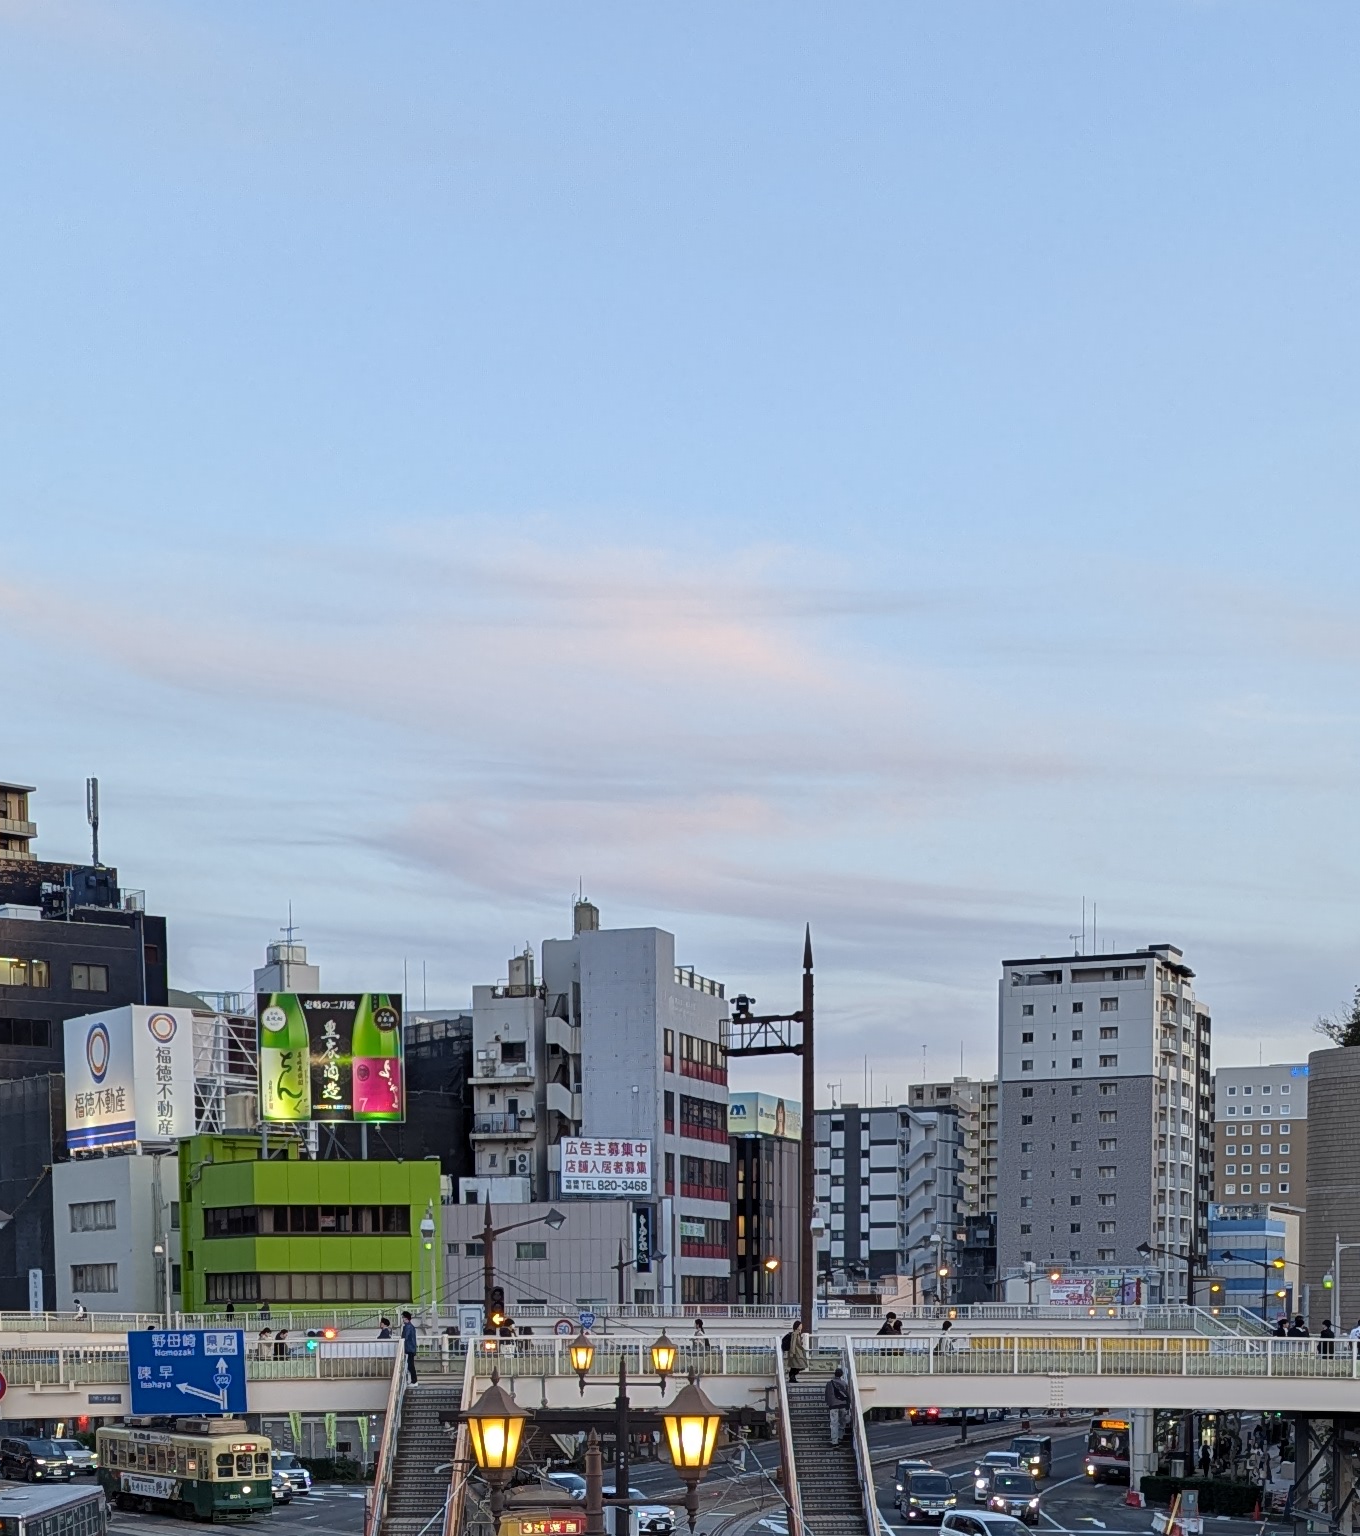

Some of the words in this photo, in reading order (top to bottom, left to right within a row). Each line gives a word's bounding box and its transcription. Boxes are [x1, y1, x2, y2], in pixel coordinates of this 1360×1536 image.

[155, 1046, 174, 1136] 福徳不動産
[74, 1086, 127, 1119] 福徳不動産
[565, 1141, 648, 1157] 広告主募集中
[565, 1161, 648, 1175] 店舗入居者募集
[581, 1181, 596, 1190] TEL
[597, 1180, 648, 1191] 820-3468
[152, 1334, 196, 1348] 野母崎
[206, 1335, 235, 1347] 県庁
[155, 1348, 195, 1356] Nomozaki
[141, 1381, 172, 1389] Isahaya
[217, 1377, 229, 1385] 202
